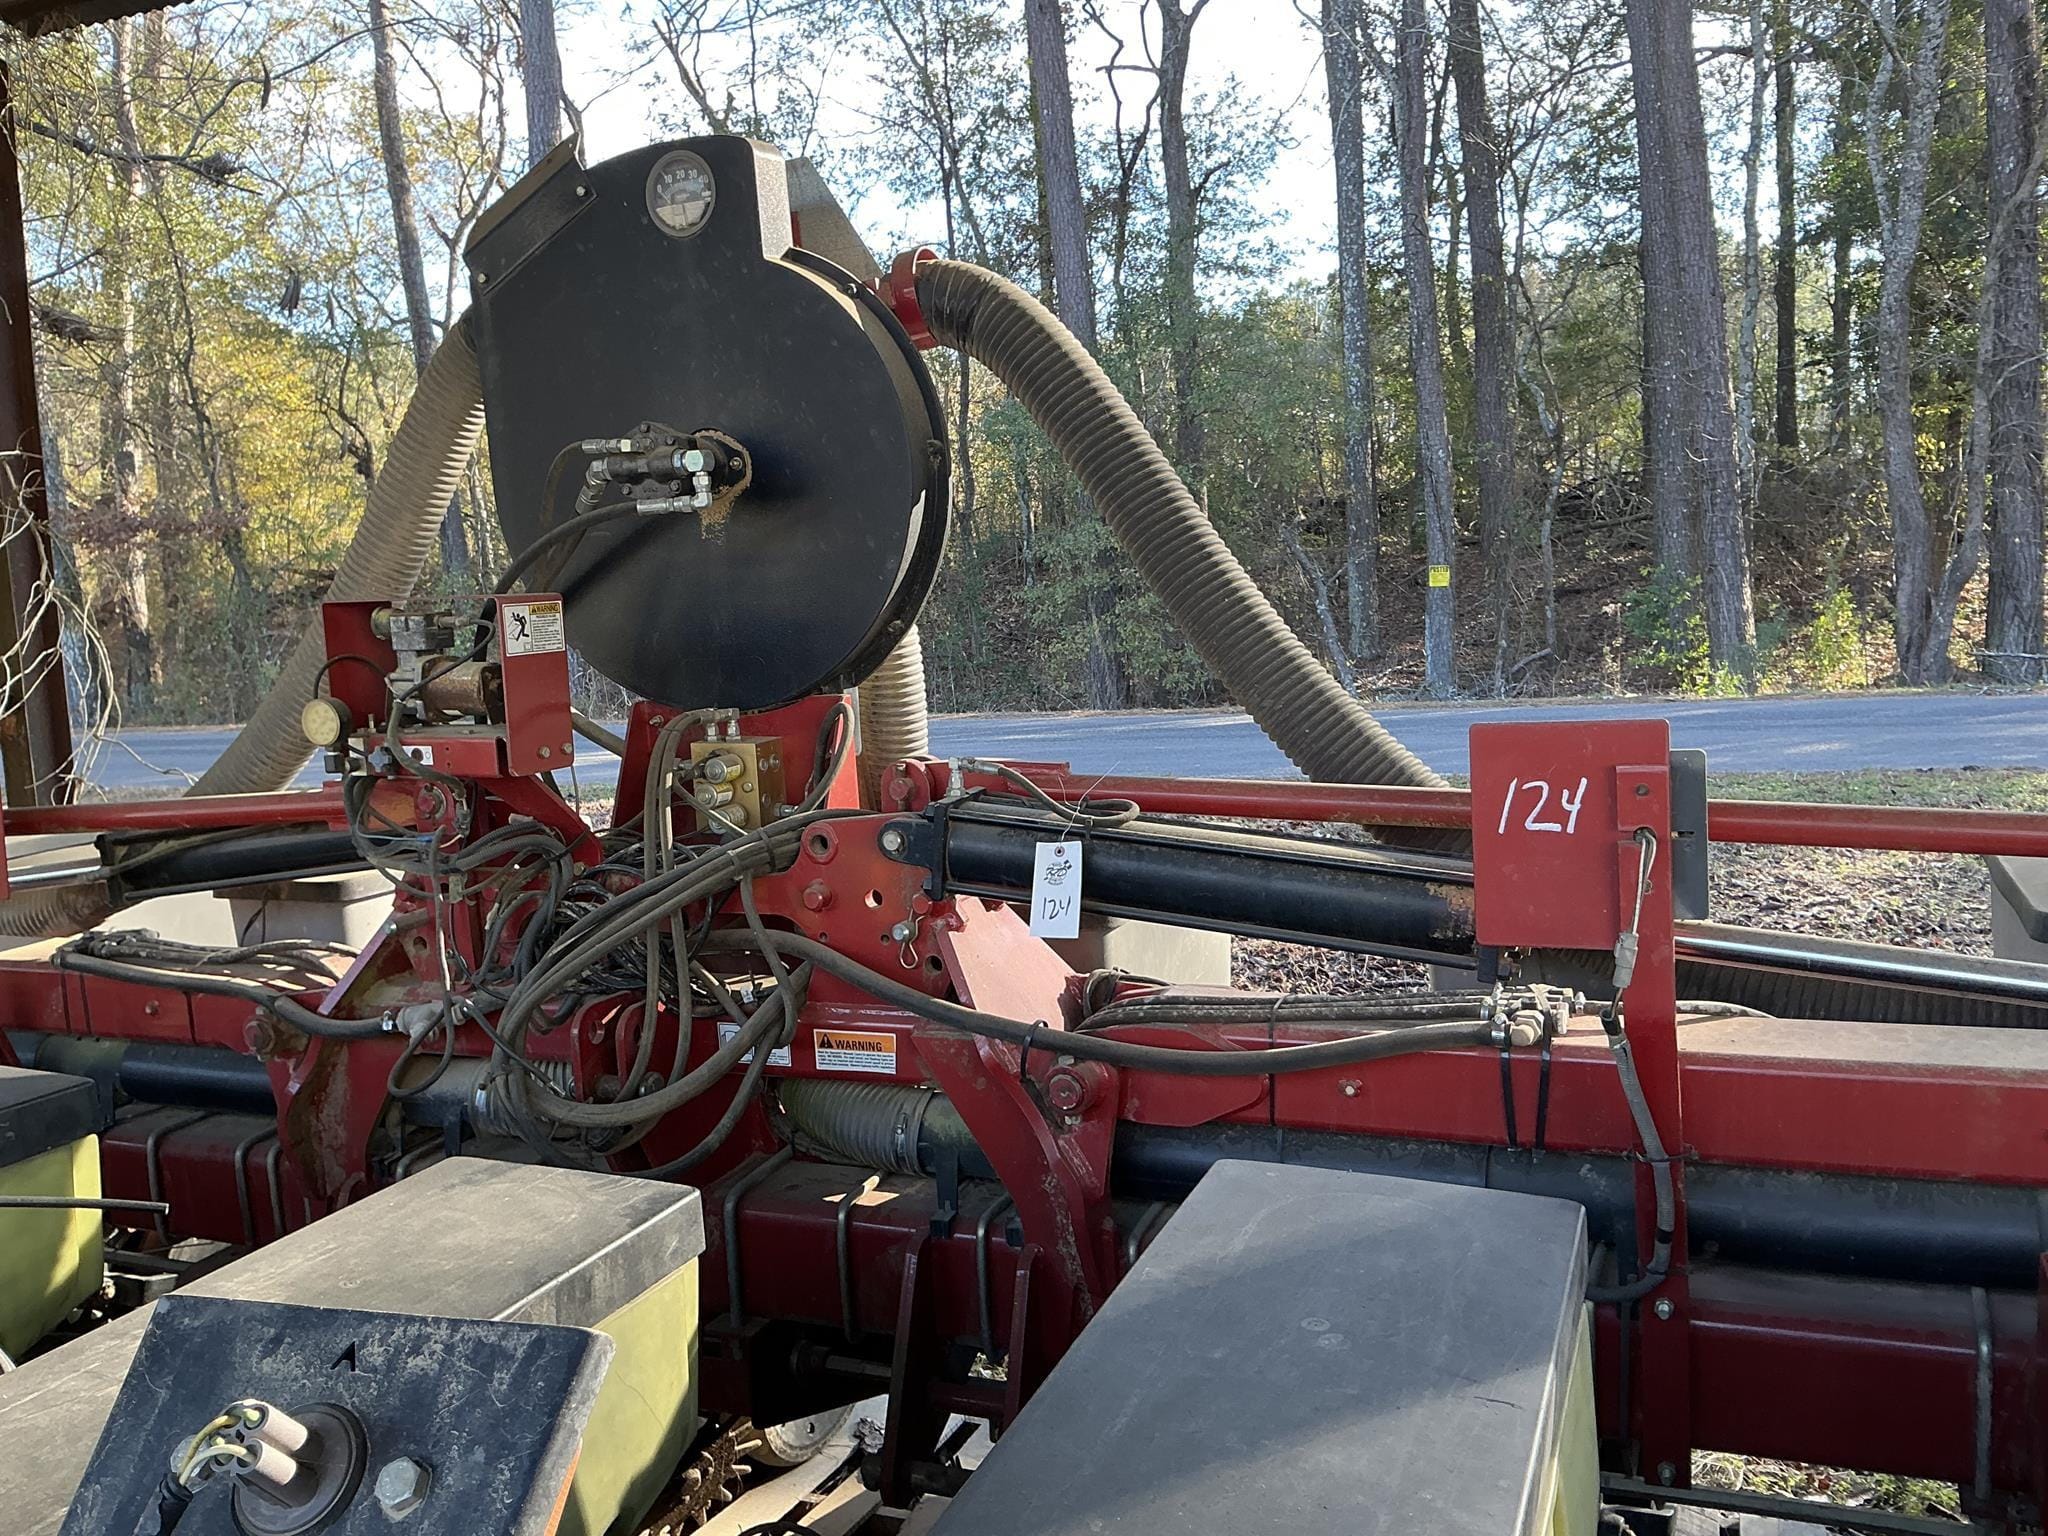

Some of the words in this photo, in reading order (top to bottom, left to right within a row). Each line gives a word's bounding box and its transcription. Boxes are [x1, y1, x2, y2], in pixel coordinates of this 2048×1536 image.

[657, 184, 662, 193] 0
[664, 174, 673, 184] 10
[676, 169, 685, 180] 20
[687, 169, 698, 179] 30
[1498, 777, 1588, 834] 124
[1042, 895, 1072, 920] 124
[834, 1039, 883, 1052] WARNING
